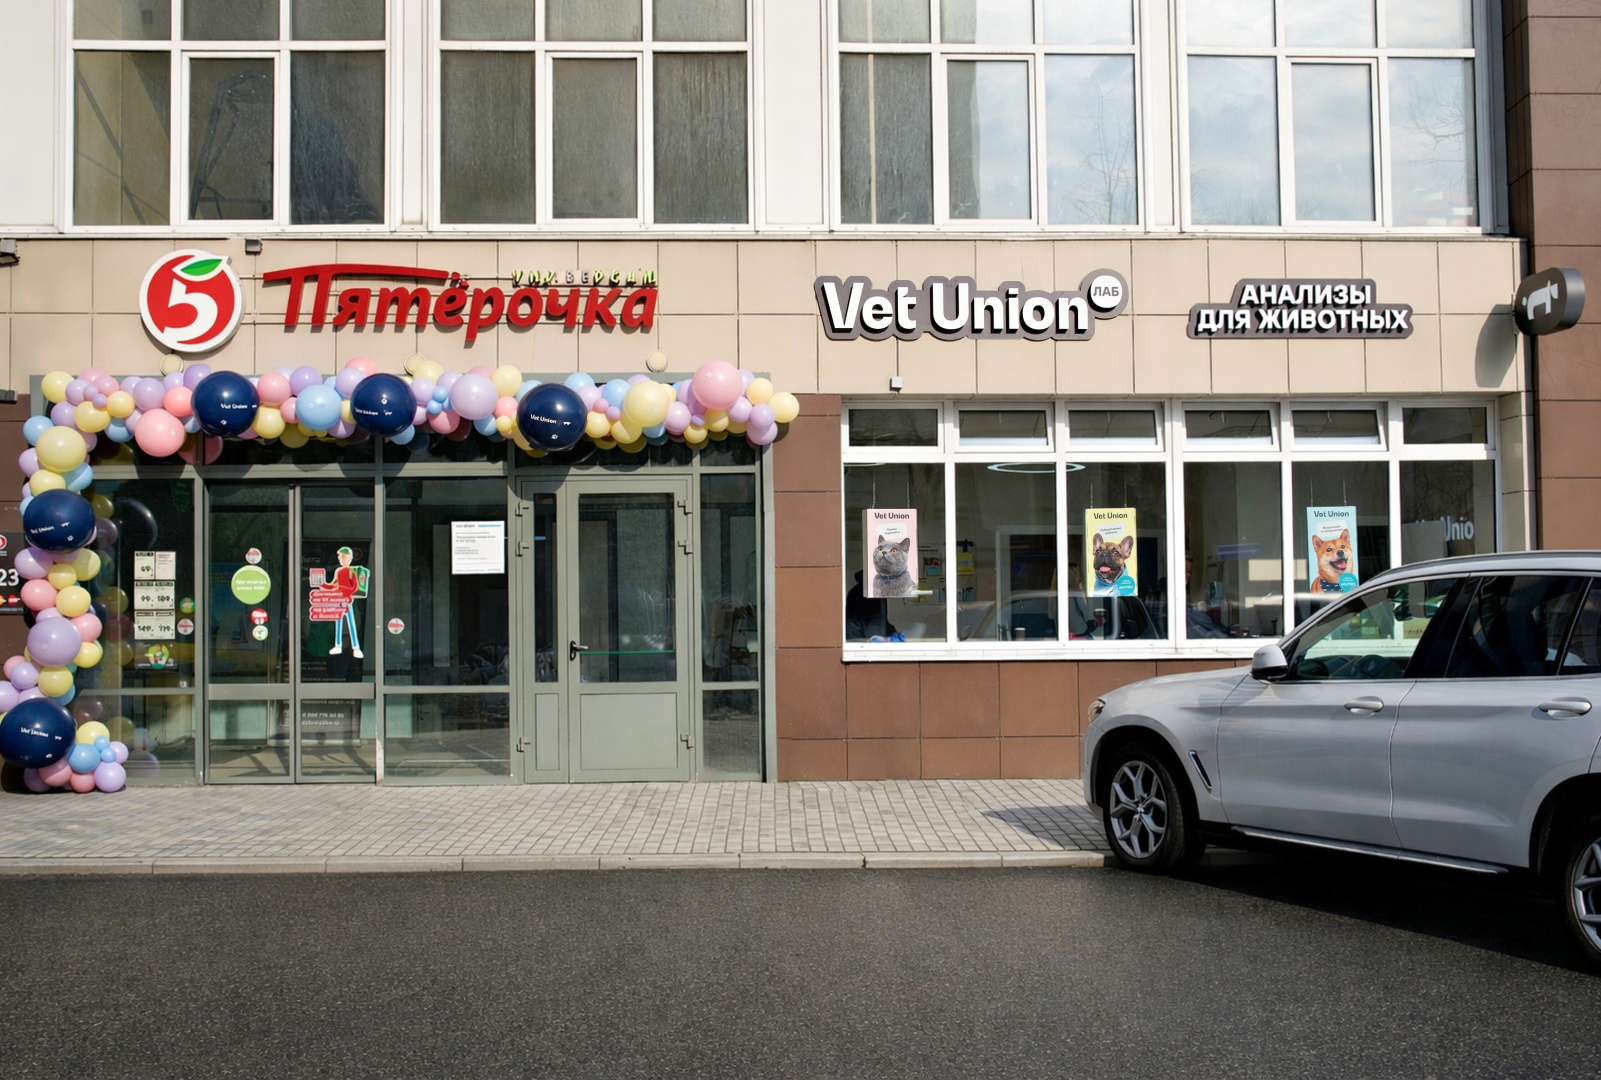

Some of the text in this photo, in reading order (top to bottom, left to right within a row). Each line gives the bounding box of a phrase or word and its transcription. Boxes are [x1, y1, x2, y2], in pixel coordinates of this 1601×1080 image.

[263, 264, 658, 342] Пятёрочка
[1092, 286, 1119, 297] ЛАБ
[1240, 284, 1371, 305] АНАЛИЗЫ
[822, 282, 1088, 331] Vet Union
[1198, 309, 1409, 332] ДЛЯ ЖИВОТНЫХ
